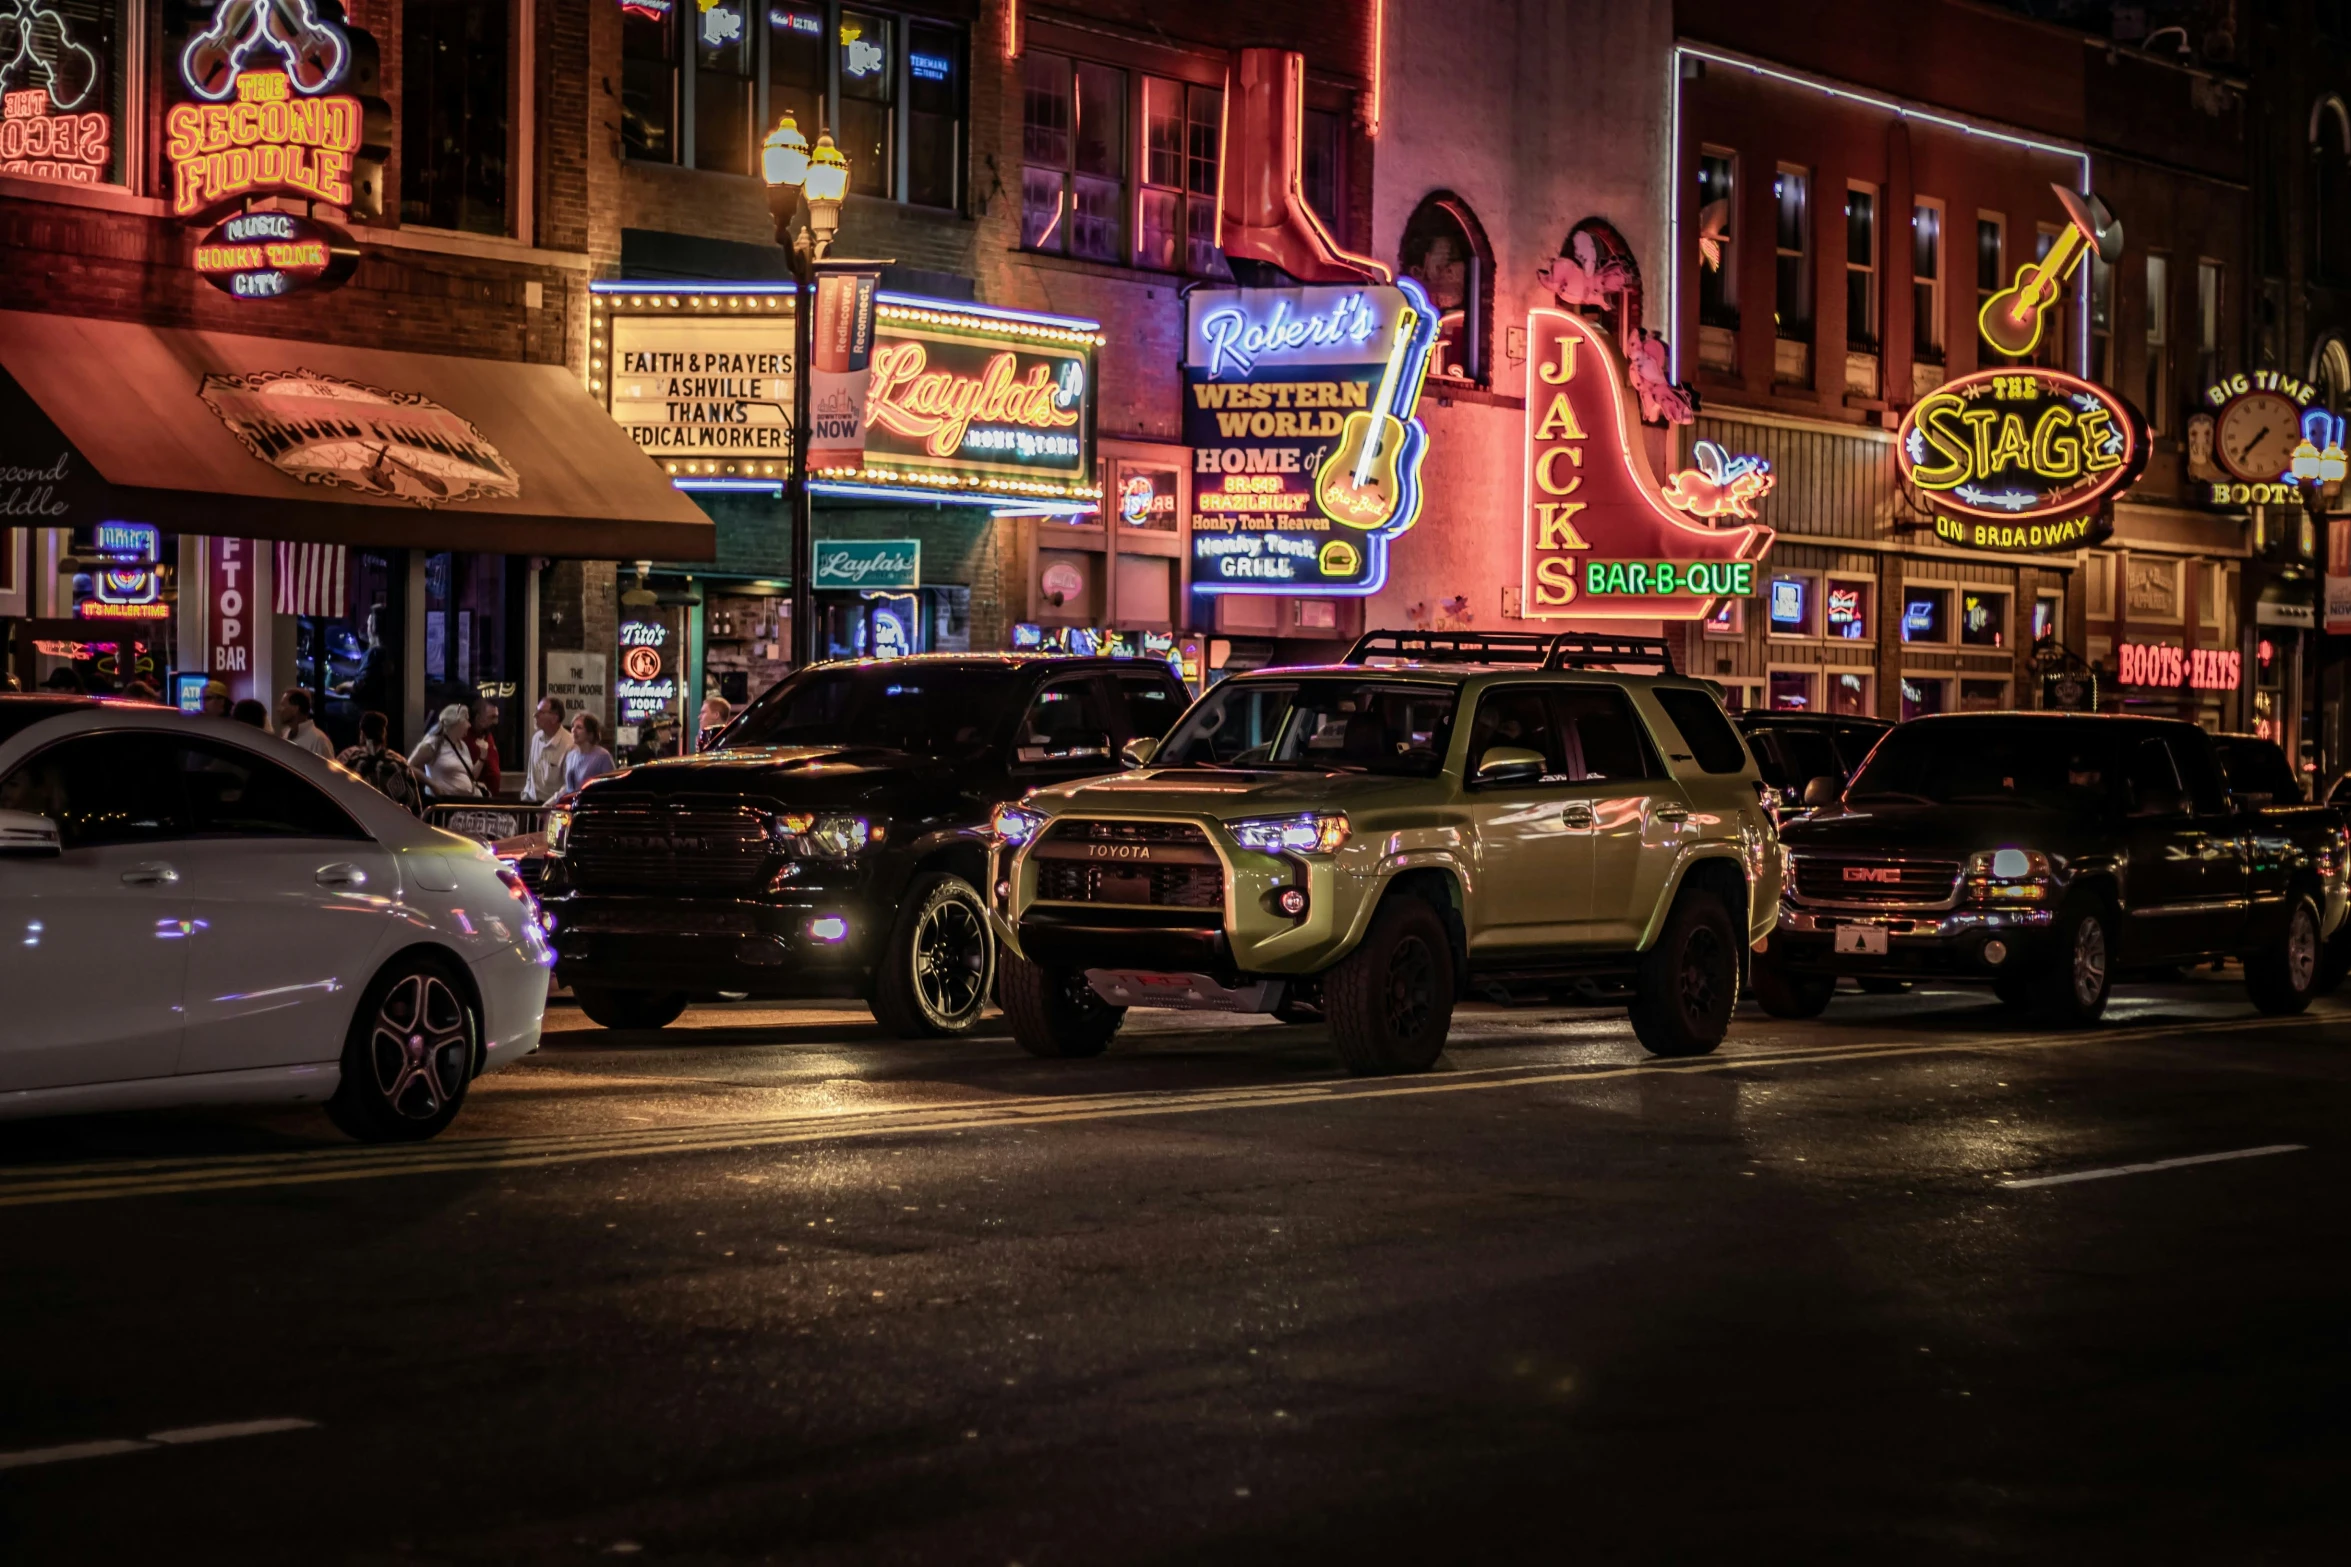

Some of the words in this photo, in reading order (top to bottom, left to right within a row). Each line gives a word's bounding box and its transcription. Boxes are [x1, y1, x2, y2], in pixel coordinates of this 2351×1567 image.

[909, 55, 948, 72] TEREMANA
[236, 72, 289, 101] THE
[170, 98, 360, 159] SECOND
[177, 146, 350, 212] FIDDLE
[228, 216, 294, 241] MUSIC
[197, 247, 262, 269] HONKY
[267, 244, 323, 267] TONK
[235, 271, 283, 295] CITY
[836, 281, 853, 353] Rediscover.
[853, 284, 870, 354] Reconnect.
[1202, 294, 1377, 379] Robert's
[624, 352, 684, 373] FAITH
[688, 354, 701, 372] &
[705, 354, 793, 374] PRAYERS
[306, 383, 338, 397] THE
[668, 378, 762, 399] ASHVILLE
[865, 343, 1078, 457] Layla's
[1193, 381, 1369, 409] WESTERN
[1992, 376, 2039, 399] THE
[2208, 373, 2250, 406] BIG
[2254, 369, 2316, 406] TIME
[666, 402, 748, 423] THANKS
[1216, 412, 1343, 438] WORLD
[699, 428, 794, 448] WORKERS
[816, 421, 858, 438] NOW
[1912, 393, 2122, 491] STAGE
[0, 452, 69, 482] econd
[1196, 448, 1300, 473] HOME
[1304, 446, 1327, 479] of
[1535, 336, 1592, 605] JACKS
[1225, 475, 1284, 493] BR-549
[2211, 482, 2304, 505] BOOTS
[1199, 493, 1310, 513] BRAZILBILLY
[1192, 513, 1236, 534] Honky
[1239, 513, 1274, 530] Tonk
[1277, 514, 1331, 531] Heaven
[1937, 516, 1964, 541] ON
[1975, 516, 2091, 547] BROADWAY
[1197, 535, 1261, 558] Honky
[1264, 534, 1317, 559] Tonk
[819, 552, 914, 582] Layla's
[1220, 557, 1293, 578] GRILL
[1587, 562, 1751, 595] BAR-B-QUE
[84, 603, 102, 616] IT'S
[104, 604, 139, 617] MILLER
[140, 605, 167, 617] TIME
[623, 622, 666, 646] Tito's
[216, 646, 246, 671] BAR
[2118, 641, 2183, 688] BOOTS
[2189, 649, 2241, 690] HATS
[570, 668, 583, 679] THE
[548, 684, 576, 695] ROBERT
[578, 684, 603, 696] MOORE
[629, 699, 664, 710] VODKA
[1088, 844, 1151, 859] TOYOTA
[1843, 867, 1901, 883] GMC
